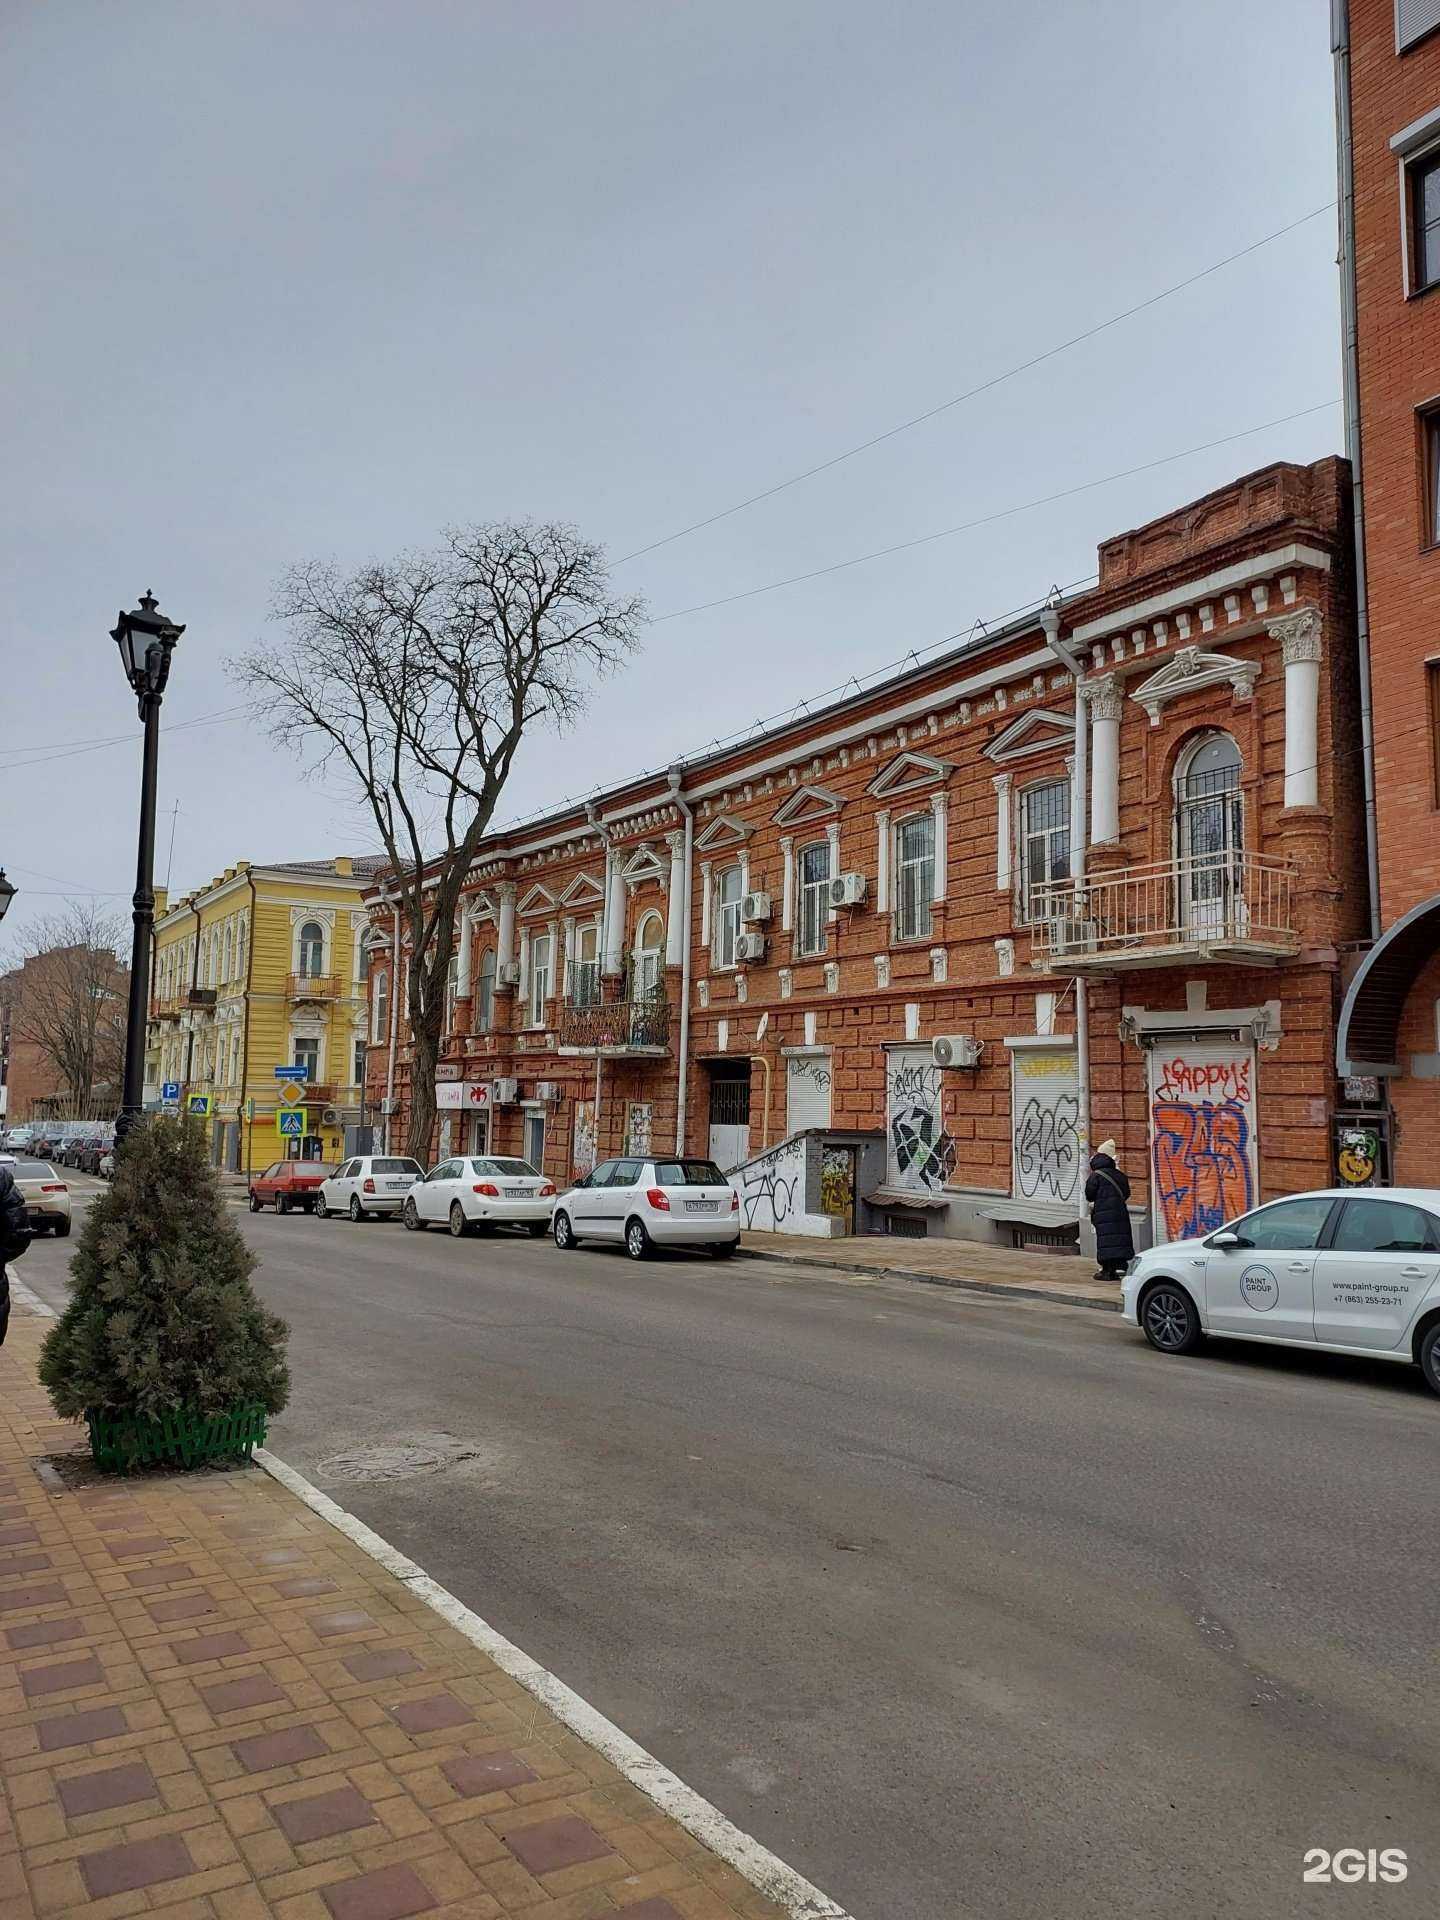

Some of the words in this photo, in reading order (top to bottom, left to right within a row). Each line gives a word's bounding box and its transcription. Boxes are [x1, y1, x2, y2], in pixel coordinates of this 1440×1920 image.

[167, 1084, 177, 1097] P
[1245, 1277, 1266, 1285] PAINT
[1246, 1284, 1272, 1293] GROUP
[1332, 1282, 1409, 1294] www.paint-group.ru
[1344, 1295, 1364, 1304] (863)
[1365, 1296, 1402, 1306] 255-23-71
